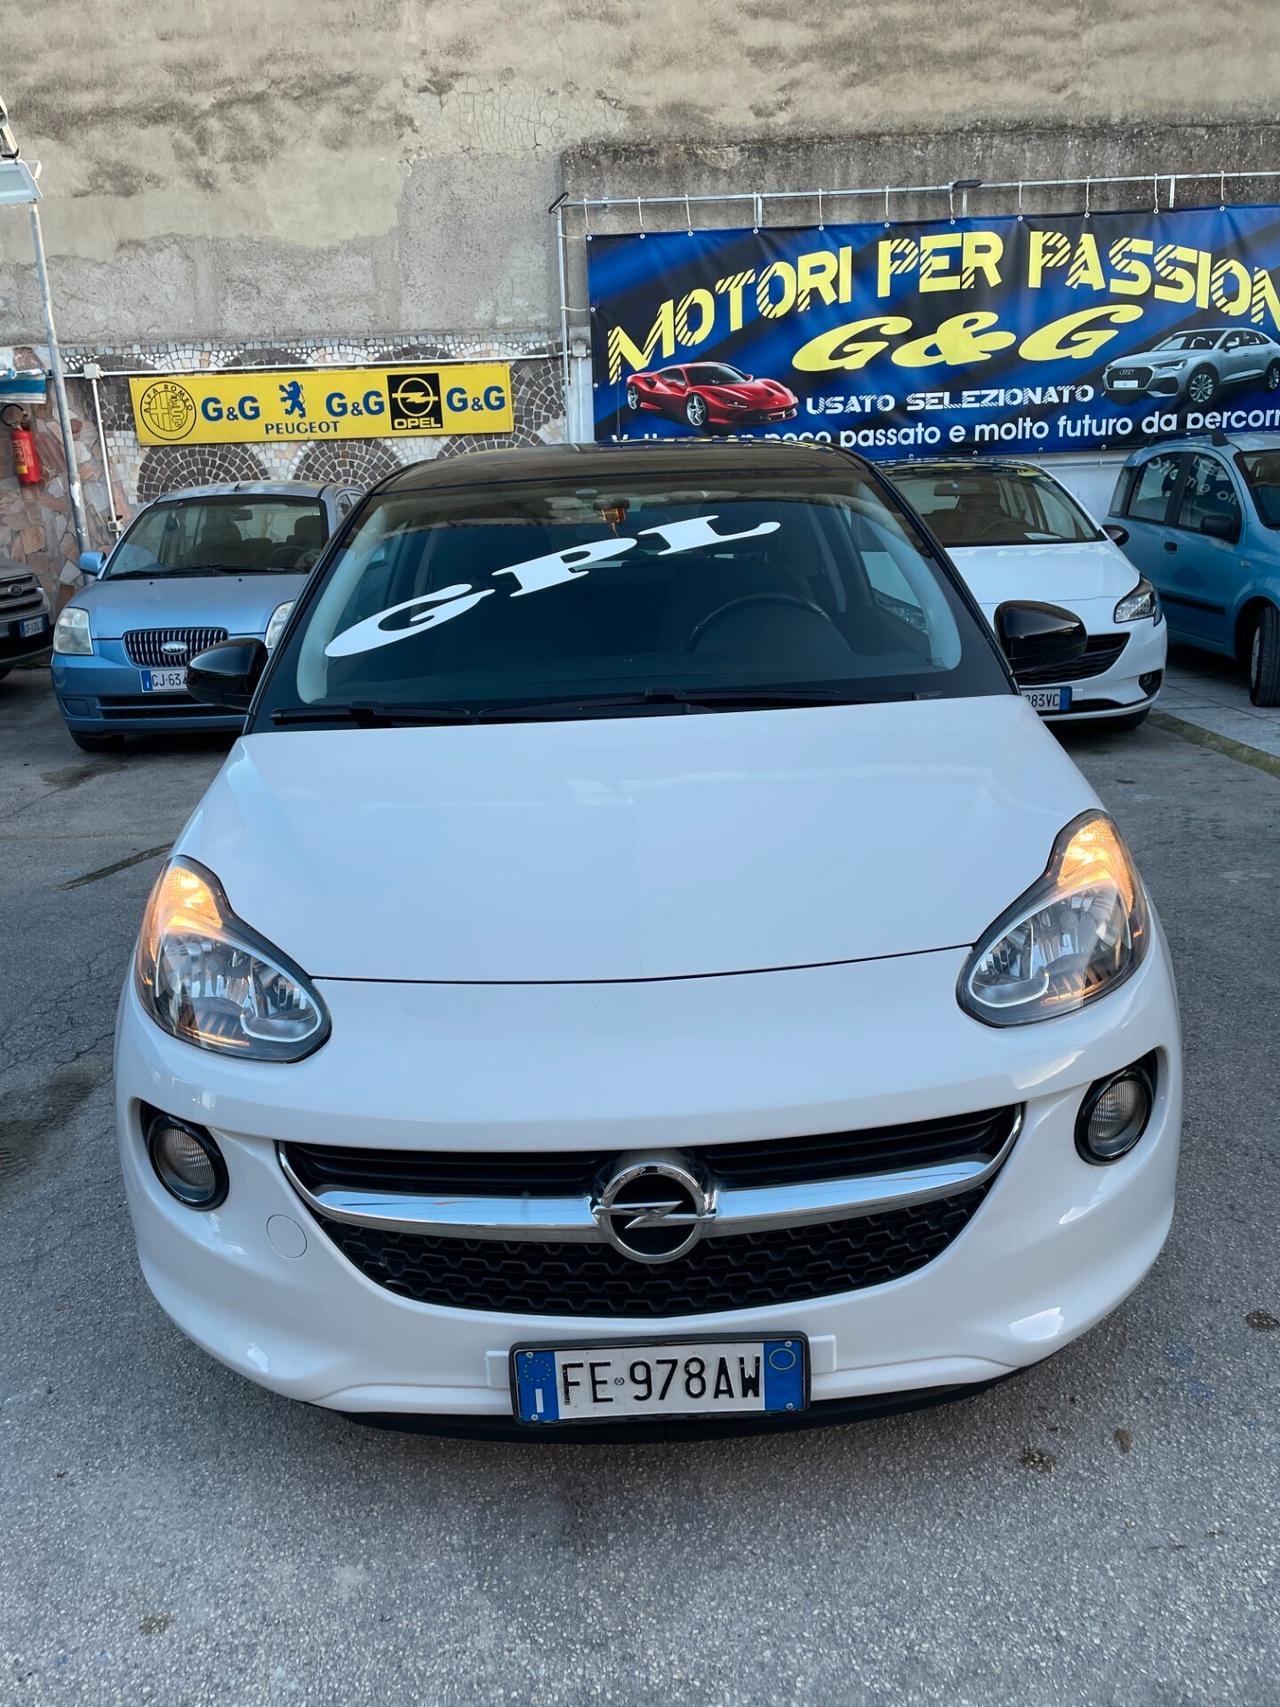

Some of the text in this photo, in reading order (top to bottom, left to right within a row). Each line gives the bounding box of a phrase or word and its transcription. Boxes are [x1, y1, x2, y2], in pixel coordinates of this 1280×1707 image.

[607, 246, 852, 386] MOTORI
[877, 231, 1004, 298] PER
[792, 304, 1144, 372] G&G
[143, 384, 194, 413] ALFA ROMEO
[201, 395, 261, 422] G&G
[325, 390, 385, 417] G&G
[446, 385, 506, 412] G&G
[806, 384, 1095, 415] USATO SELEZIONATO
[264, 420, 340, 435] PEUGEOT
[393, 417, 442, 429] OPEL
[840, 421, 942, 448] passato
[948, 425, 967, 443] e
[974, 417, 1050, 441] molto
[1057, 414, 1133, 437] futuro
[1141, 411, 1178, 434] da
[325, 515, 781, 657] GPL
